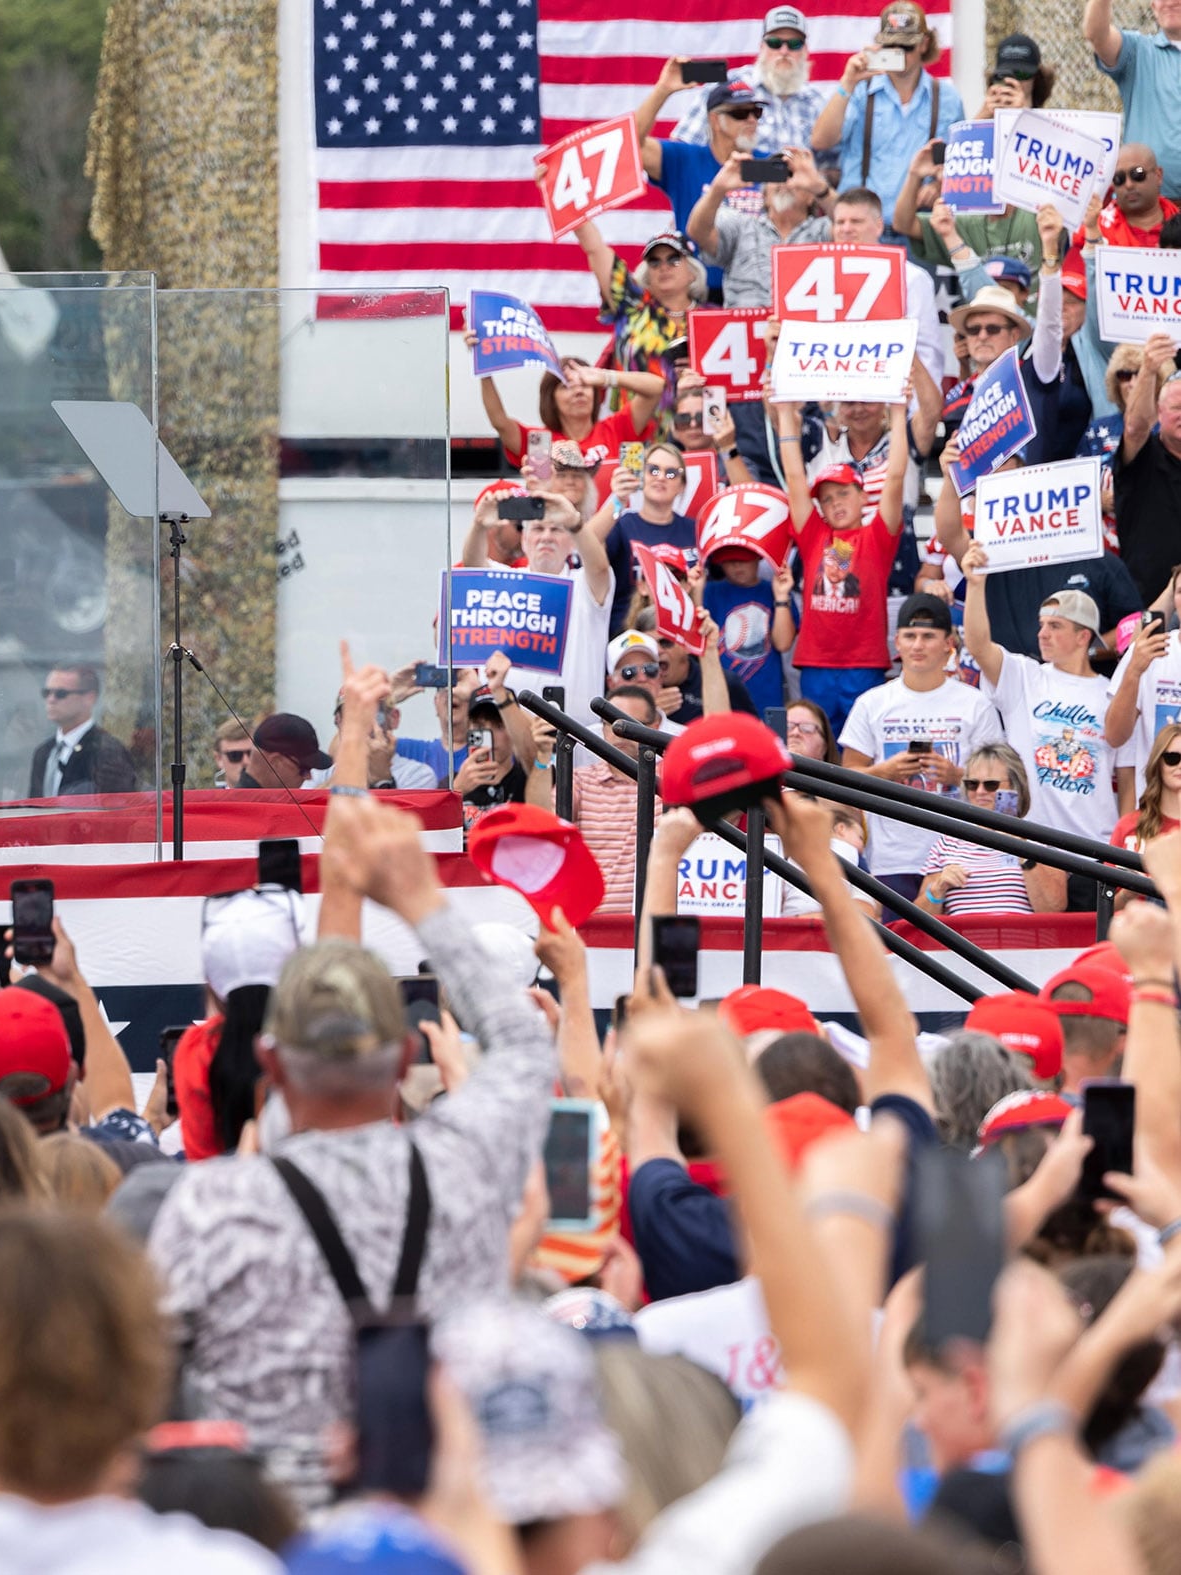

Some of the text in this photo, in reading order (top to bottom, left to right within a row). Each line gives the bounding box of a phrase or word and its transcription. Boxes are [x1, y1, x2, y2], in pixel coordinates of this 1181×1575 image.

[552, 127, 624, 211] 47
[945, 157, 996, 177] OUGH
[1015, 132, 1094, 179] TRUMP
[1018, 157, 1082, 196] VANCE
[784, 256, 892, 321] 47
[789, 341, 904, 358] TRUMP
[798, 358, 887, 373] VANCE
[957, 389, 1017, 451] THROUGH
[959, 405, 1024, 470] STRENGTH
[984, 484, 1091, 520] TRUMP
[699, 491, 789, 549] 47
[994, 508, 1079, 537] VANCE
[1008, 534, 1038, 543] AMERICA
[466, 589, 542, 613] PEACE
[655, 560, 695, 632] 47
[451, 609, 557, 635] THROUGH
[1038, 766, 1092, 795] Felon
[678, 859, 747, 880] RUM
[678, 880, 747, 899] ANC
